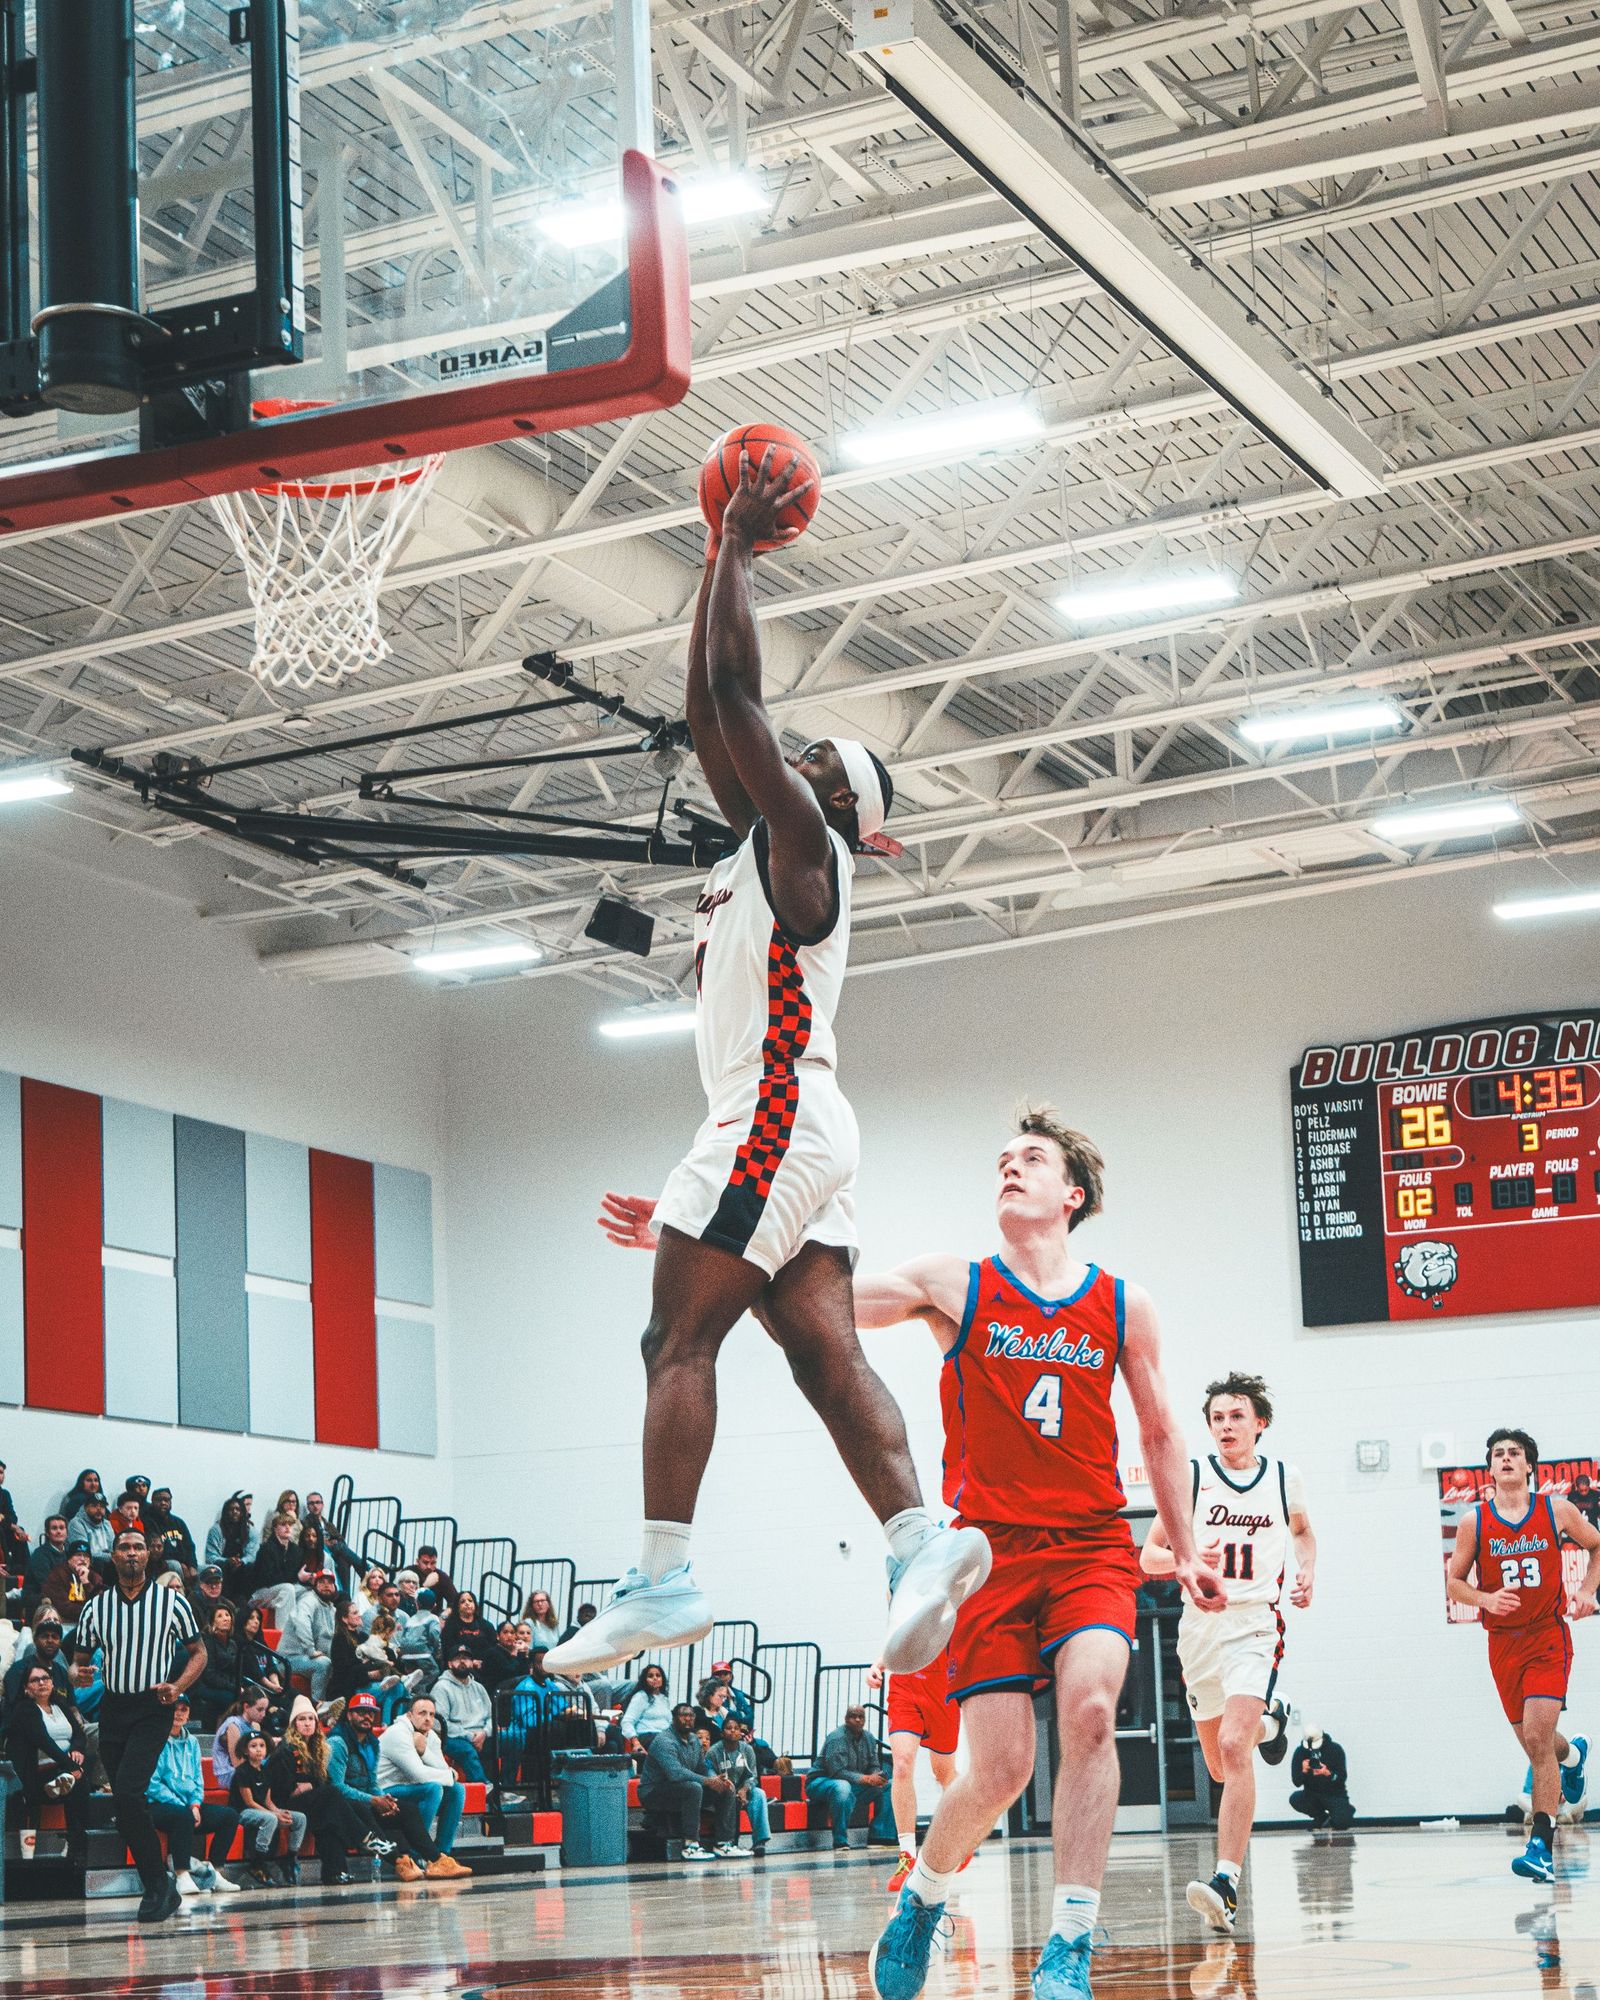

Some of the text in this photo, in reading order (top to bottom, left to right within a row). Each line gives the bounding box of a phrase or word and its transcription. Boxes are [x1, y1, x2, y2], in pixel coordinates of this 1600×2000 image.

[1300, 1026, 1539, 1088] BULLDOG
[1392, 1082, 1448, 1105] BOWIE
[1497, 1068, 1584, 1113] 4:35
[1294, 1099, 1364, 1117] BOYS VARSITY
[1511, 1111, 1546, 1120] SPECTRUM
[1307, 1116, 1331, 1129] PELZ
[1400, 1105, 1451, 1149] 26
[1296, 1127, 1357, 1144] 1 FILDERMAN
[1521, 1123, 1539, 1152] 3
[1546, 1127, 1579, 1140] PERIOD
[1296, 1141, 1351, 1159] 2 OSOBASE
[1297, 1157, 1340, 1172] 3 ASHBY
[1489, 1158, 1579, 1180] PLAYER FOULS
[1297, 1170, 1346, 1186] 4 BASKIN
[1399, 1172, 1432, 1187] FOULS
[1298, 1185, 1340, 1200] 5 JABBI
[1300, 1199, 1340, 1213] 10 RYAN
[1397, 1187, 1433, 1218] 02
[1300, 1211, 1357, 1227] 11 D FRIEND
[1456, 1206, 1473, 1218] TOL
[1531, 1206, 1559, 1219] GAME
[1301, 1224, 1363, 1241] 12 ELIZONDO
[1403, 1218, 1427, 1230] WON
[984, 1322, 1105, 1369] Westlake
[1022, 1373, 1063, 1438] 4
[1206, 1504, 1273, 1536] Dawgs
[1489, 1533, 1549, 1557] Westlake
[1222, 1542, 1254, 1580] 11
[1500, 1557, 1542, 1589] 23
